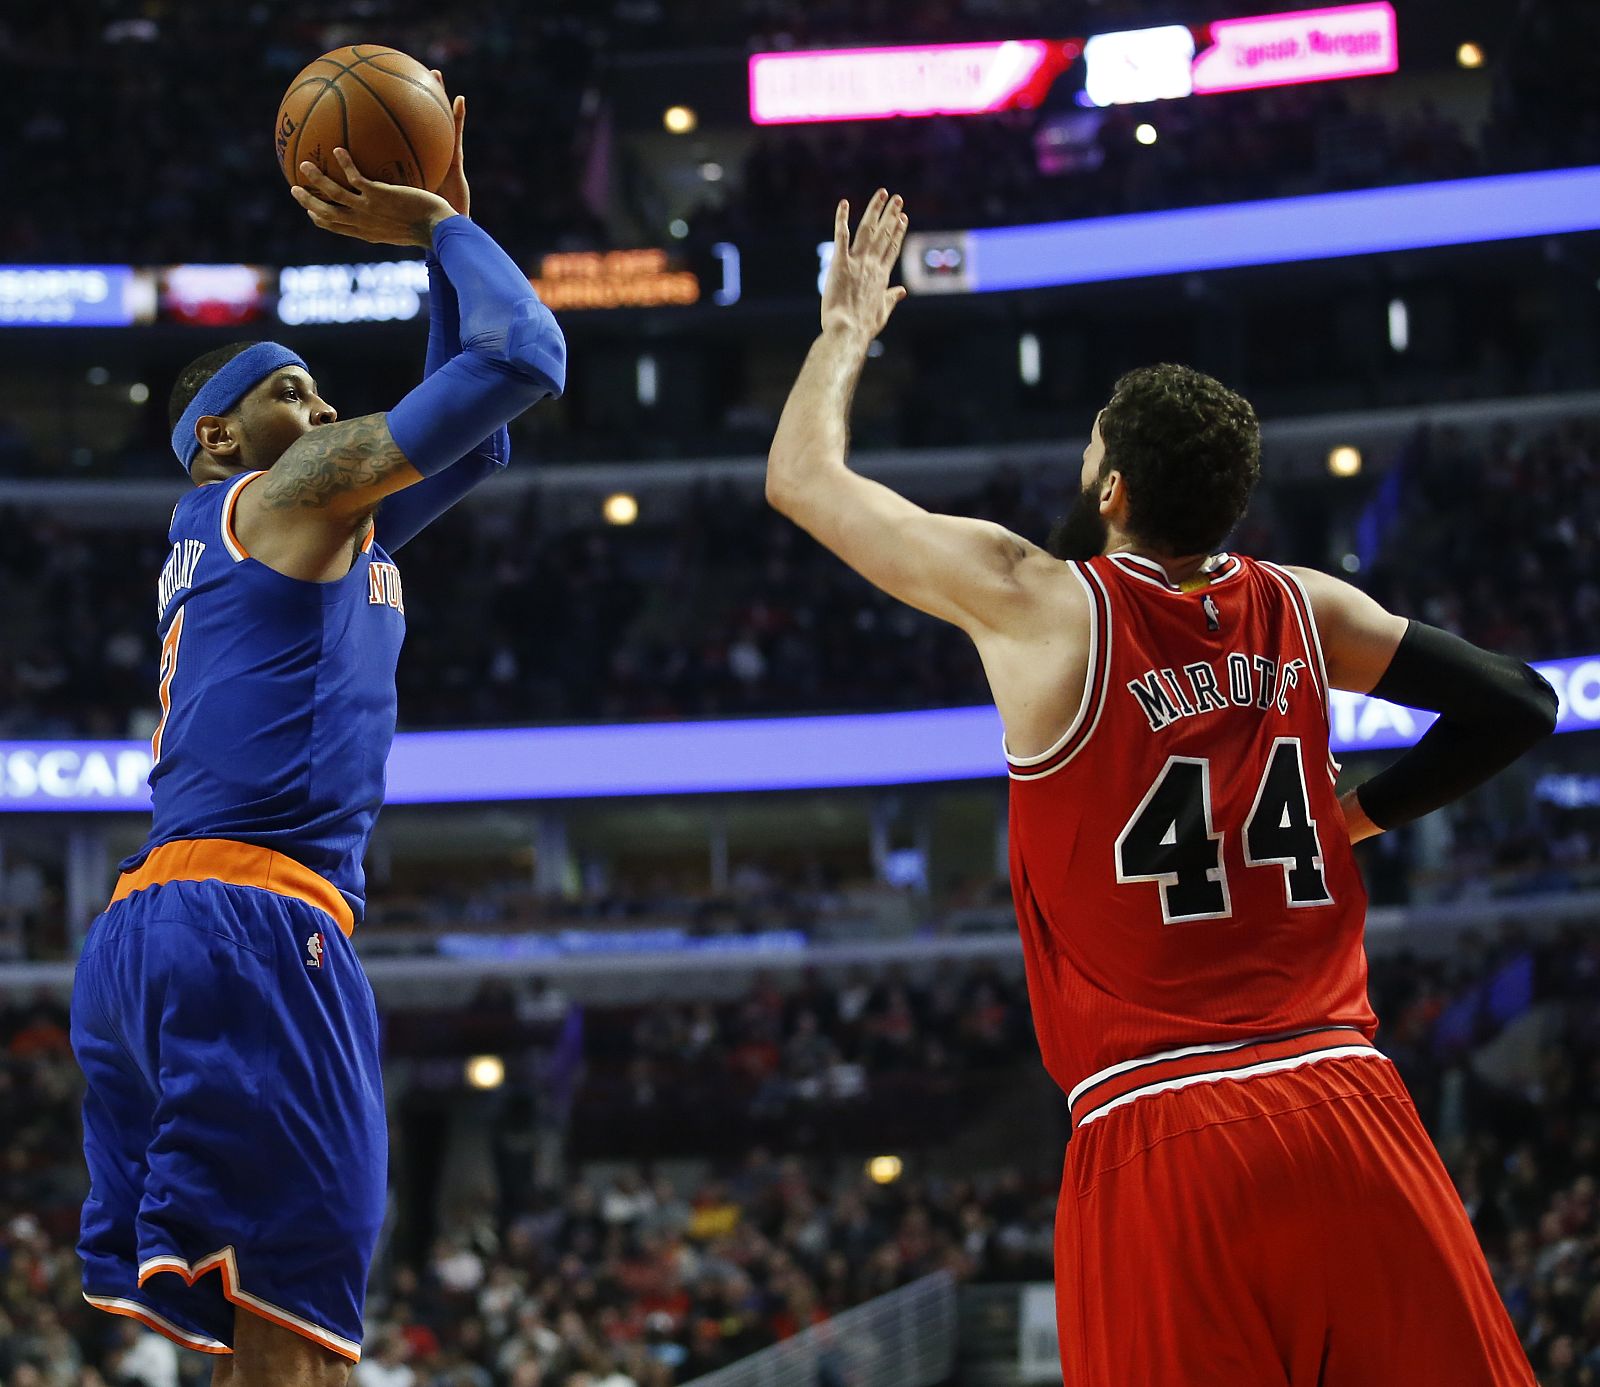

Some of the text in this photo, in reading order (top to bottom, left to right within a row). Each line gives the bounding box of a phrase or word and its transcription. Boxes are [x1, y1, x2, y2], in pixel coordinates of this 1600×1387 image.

[158, 538, 206, 622] NTHONY
[152, 604, 185, 764] 7
[1127, 652, 1306, 732] MIROTĆ
[0, 749, 150, 798] SCAP
[1114, 736, 1336, 925] 44
